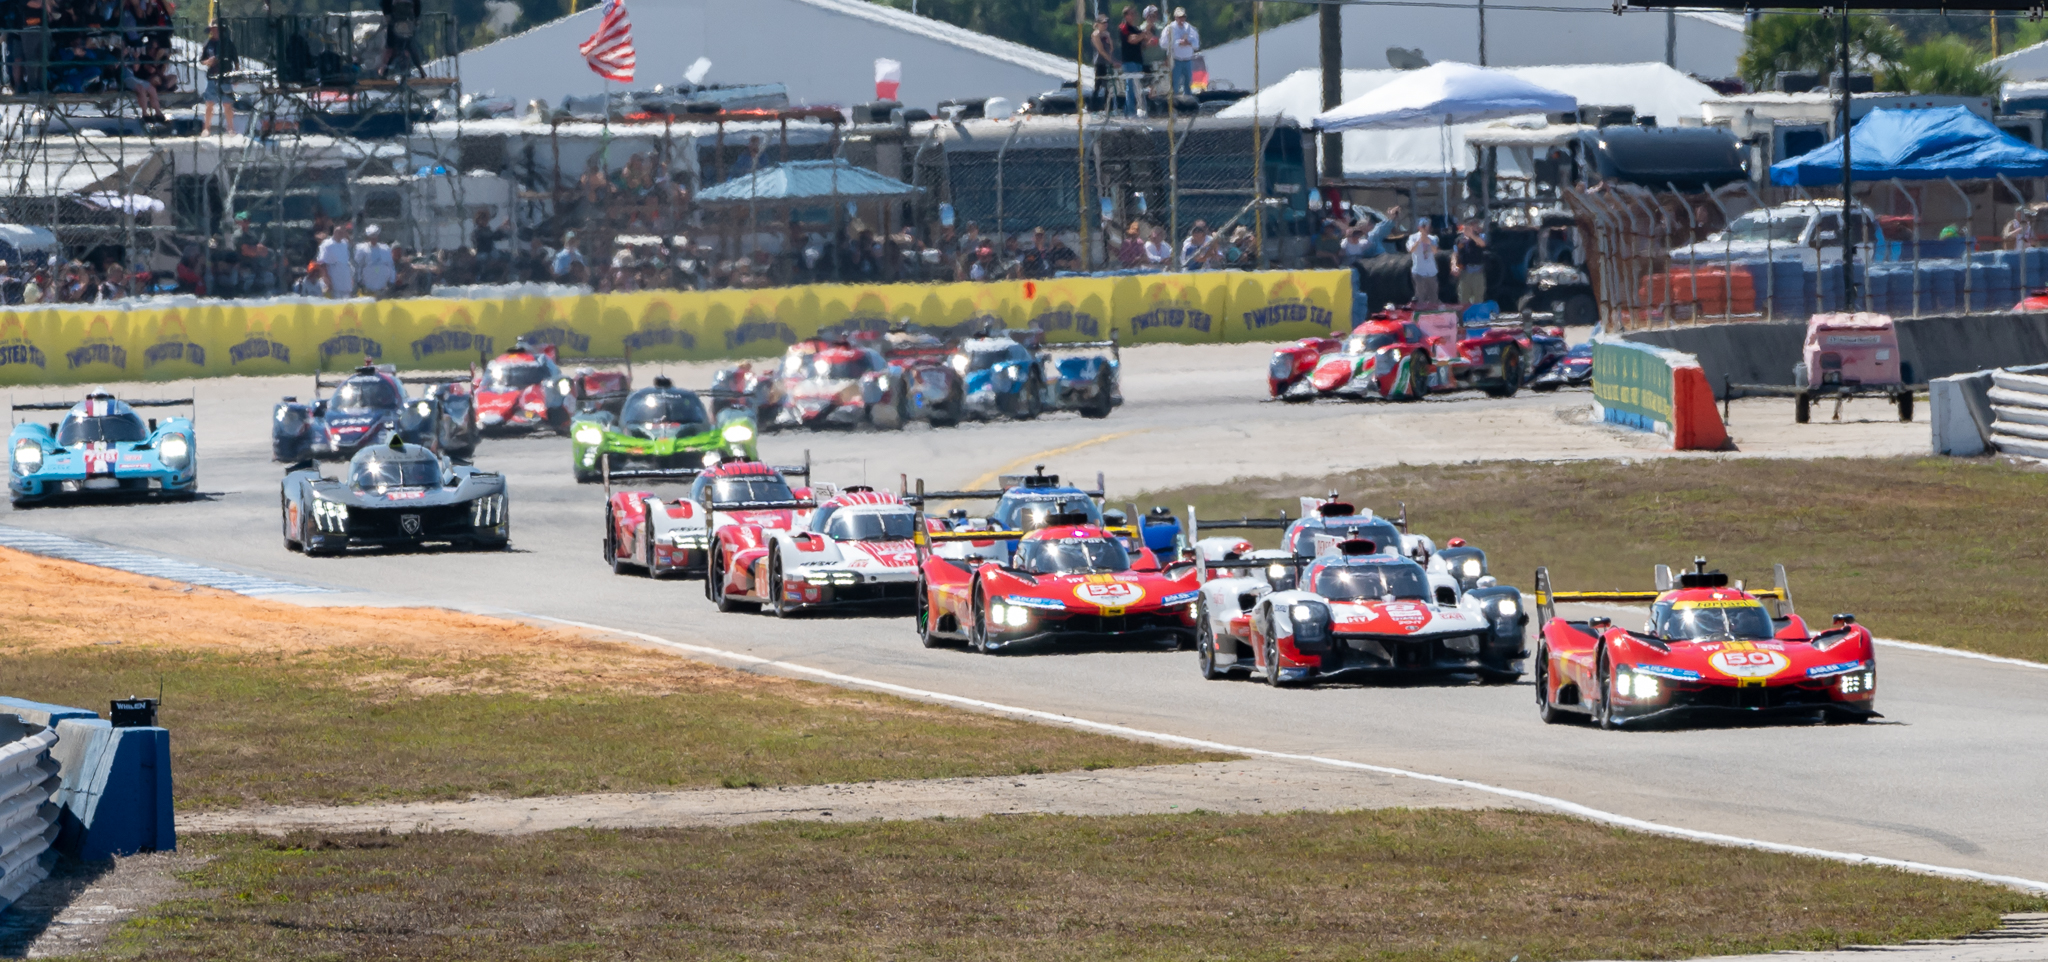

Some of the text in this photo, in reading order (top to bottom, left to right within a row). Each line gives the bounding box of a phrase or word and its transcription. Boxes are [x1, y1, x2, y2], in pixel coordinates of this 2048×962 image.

[1243, 304, 1333, 331] TWISTED TEA
[1089, 584, 1129, 596] 51
[1725, 653, 1771, 665] 50
[116, 702, 147, 710] WHELEN
